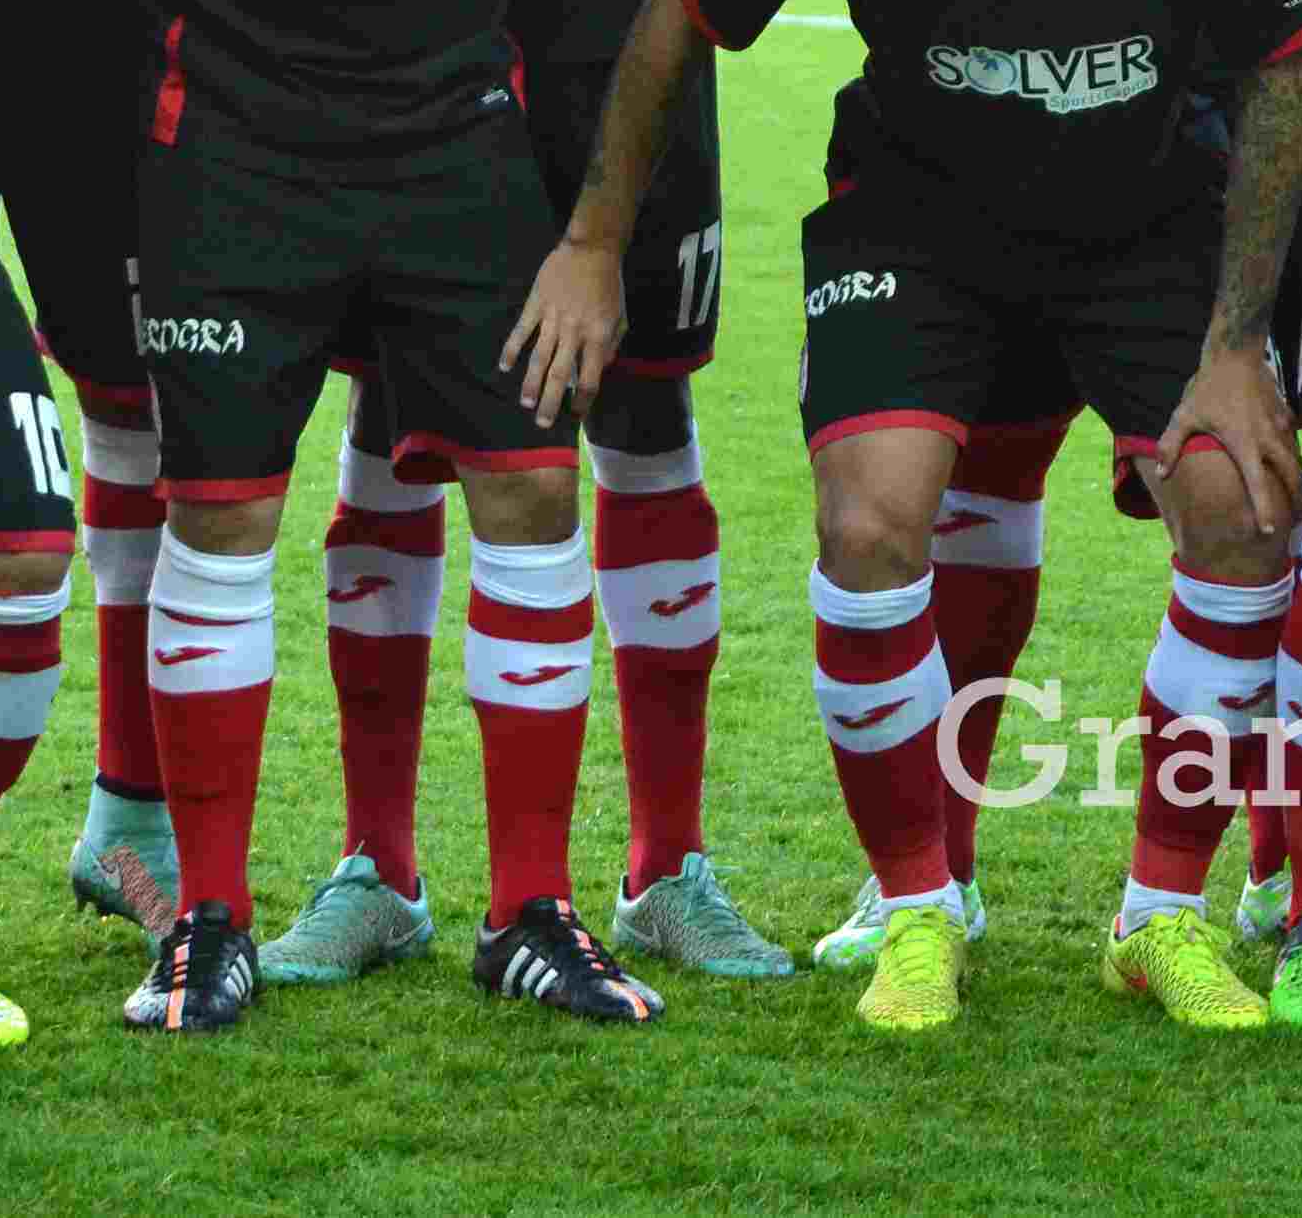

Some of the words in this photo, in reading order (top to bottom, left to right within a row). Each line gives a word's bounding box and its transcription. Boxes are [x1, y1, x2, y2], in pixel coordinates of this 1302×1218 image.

[930, 38, 1153, 93] SOLVER
[677, 222, 719, 330] 17
[9, 392, 73, 498] 10
